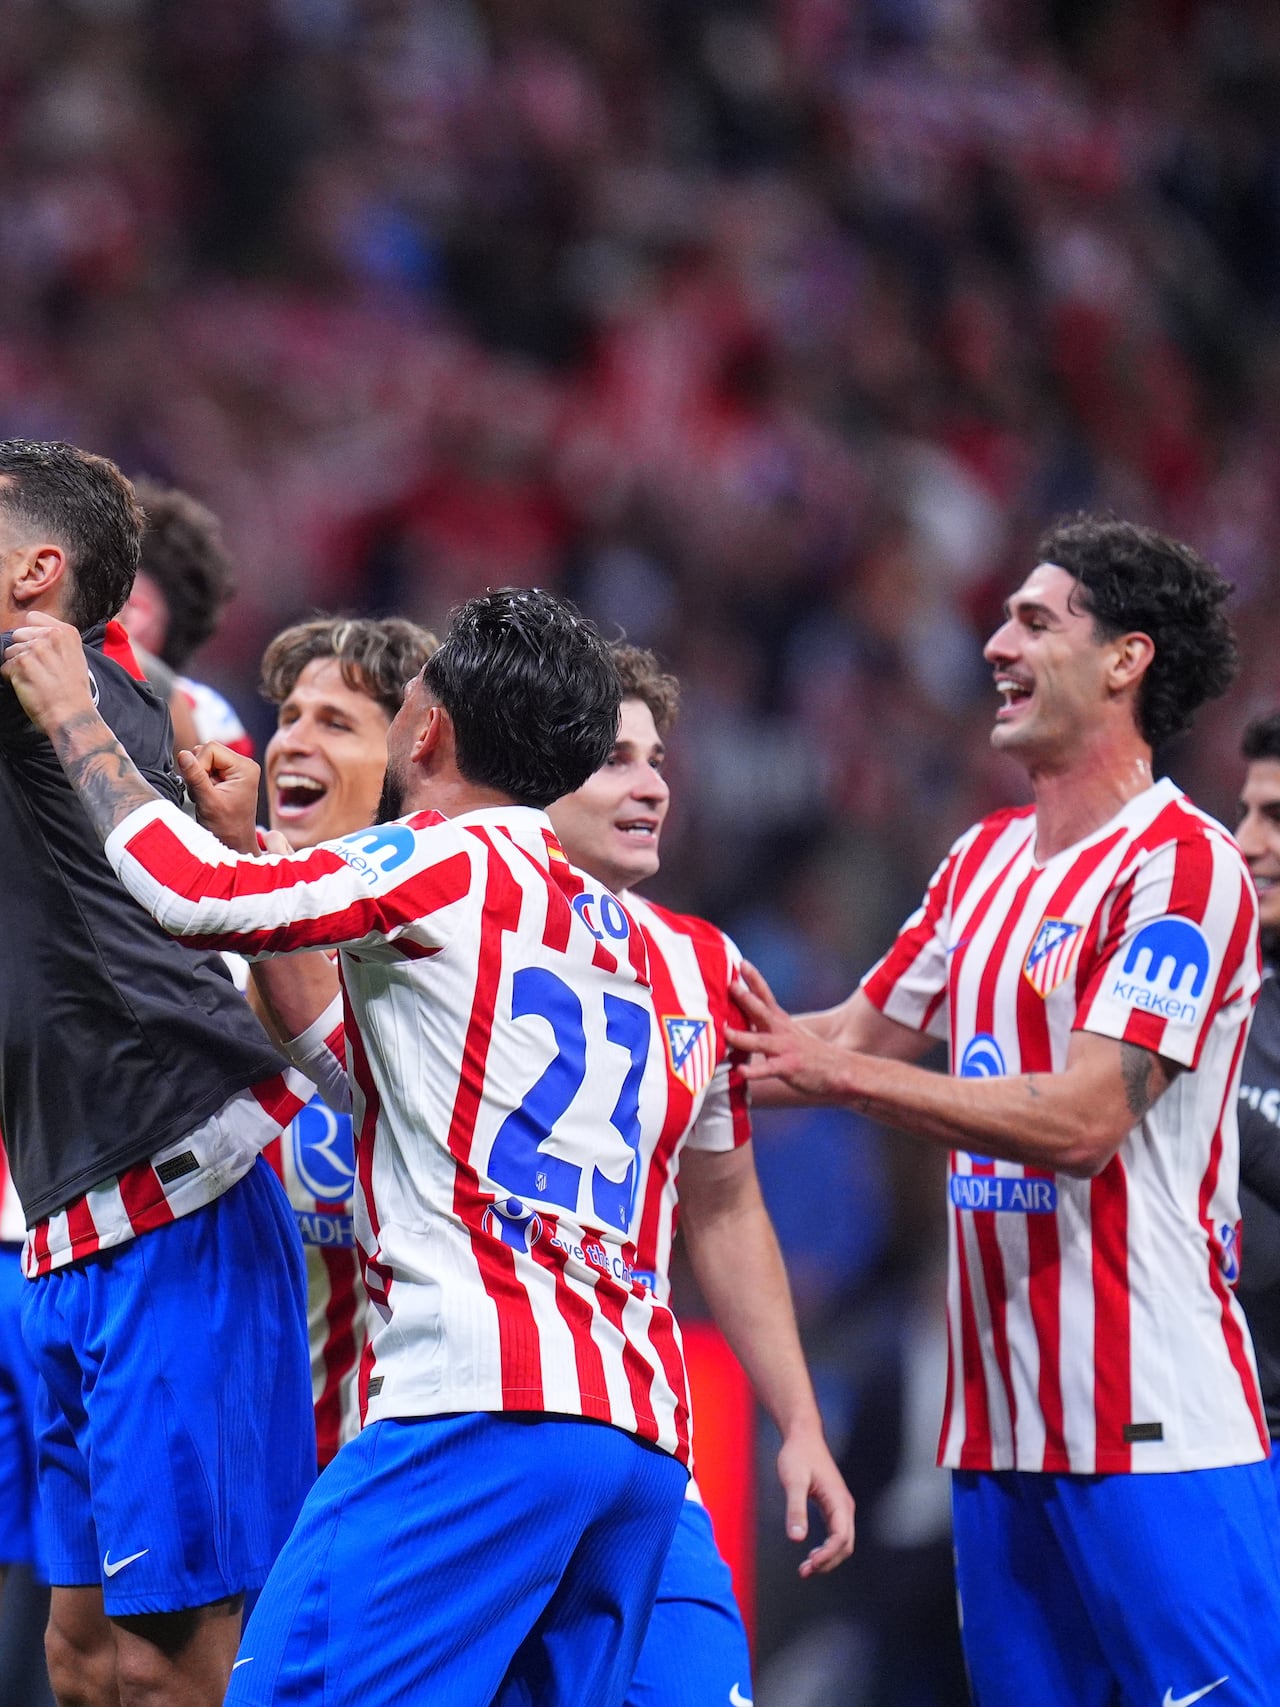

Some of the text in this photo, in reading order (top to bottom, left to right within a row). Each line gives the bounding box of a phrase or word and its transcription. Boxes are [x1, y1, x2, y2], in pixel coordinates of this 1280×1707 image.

[573, 893, 629, 940] CO
[1113, 980, 1197, 1022] kraken
[487, 966, 650, 1235] 23
[1010, 1181, 1053, 1210] AIR
